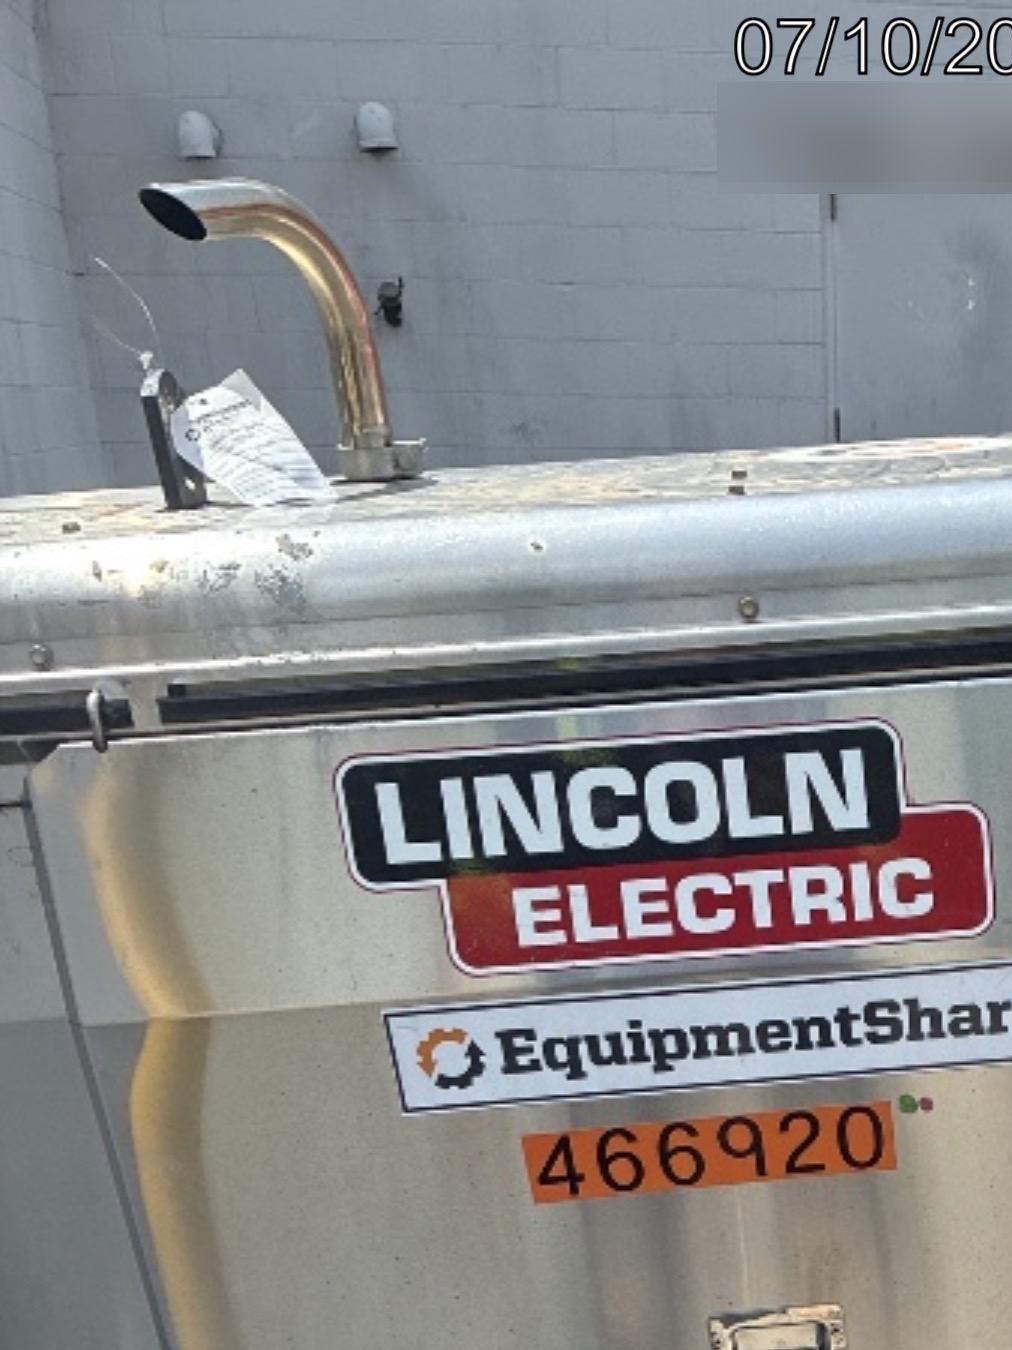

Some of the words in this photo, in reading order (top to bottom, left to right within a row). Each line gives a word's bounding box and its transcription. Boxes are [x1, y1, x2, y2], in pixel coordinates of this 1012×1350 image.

[374, 748, 869, 865] LINCOLN
[510, 857, 934, 948] ELECTRIC
[536, 1106, 885, 1196] 466920
